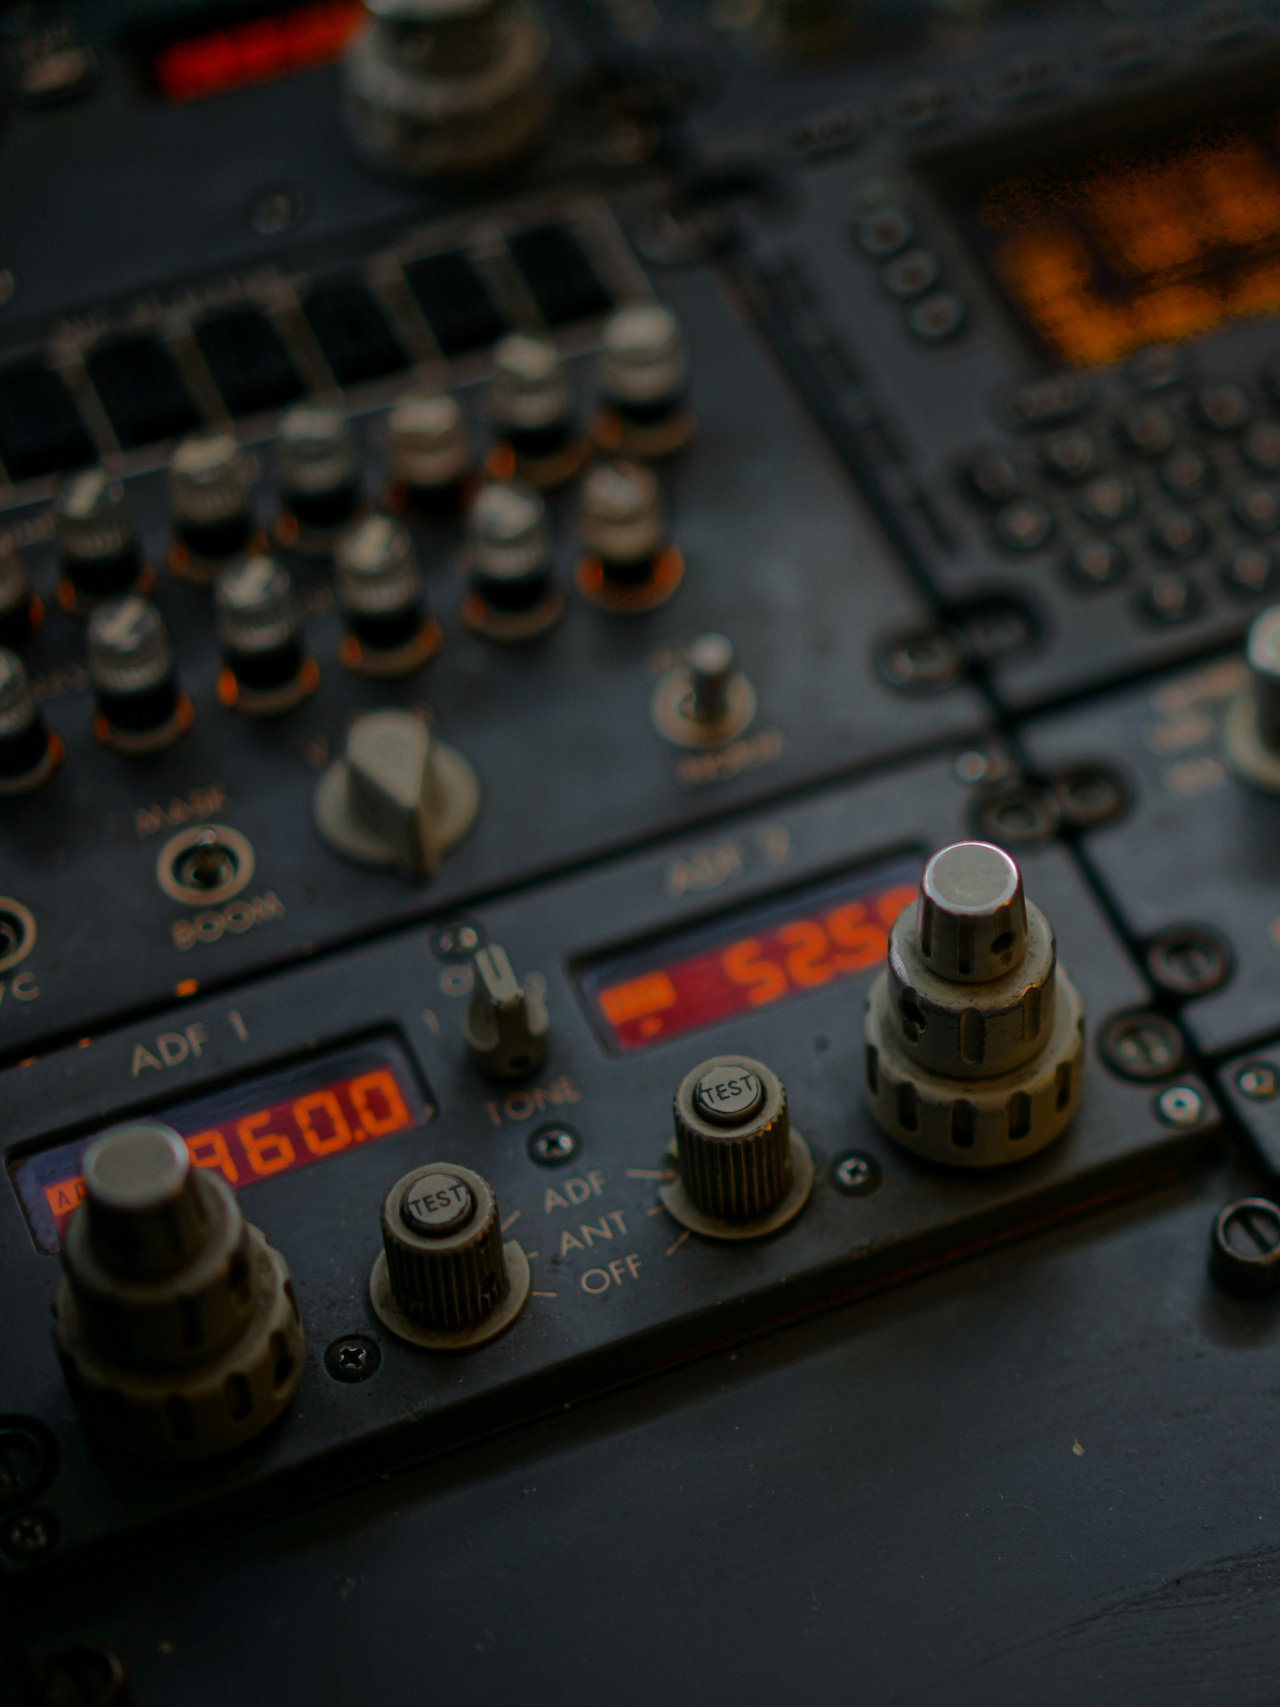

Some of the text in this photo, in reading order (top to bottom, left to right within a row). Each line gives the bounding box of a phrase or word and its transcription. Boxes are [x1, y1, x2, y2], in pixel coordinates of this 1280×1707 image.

[171, 889, 285, 951] BOOM
[131, 1010, 248, 1078] ADF 1
[484, 1074, 582, 1126] TONE
[698, 1075, 752, 1104] TEST
[407, 1184, 463, 1217] TEST
[545, 1168, 607, 1214] ADF
[561, 1209, 628, 1256] ANT
[580, 1253, 642, 1294] OFF
